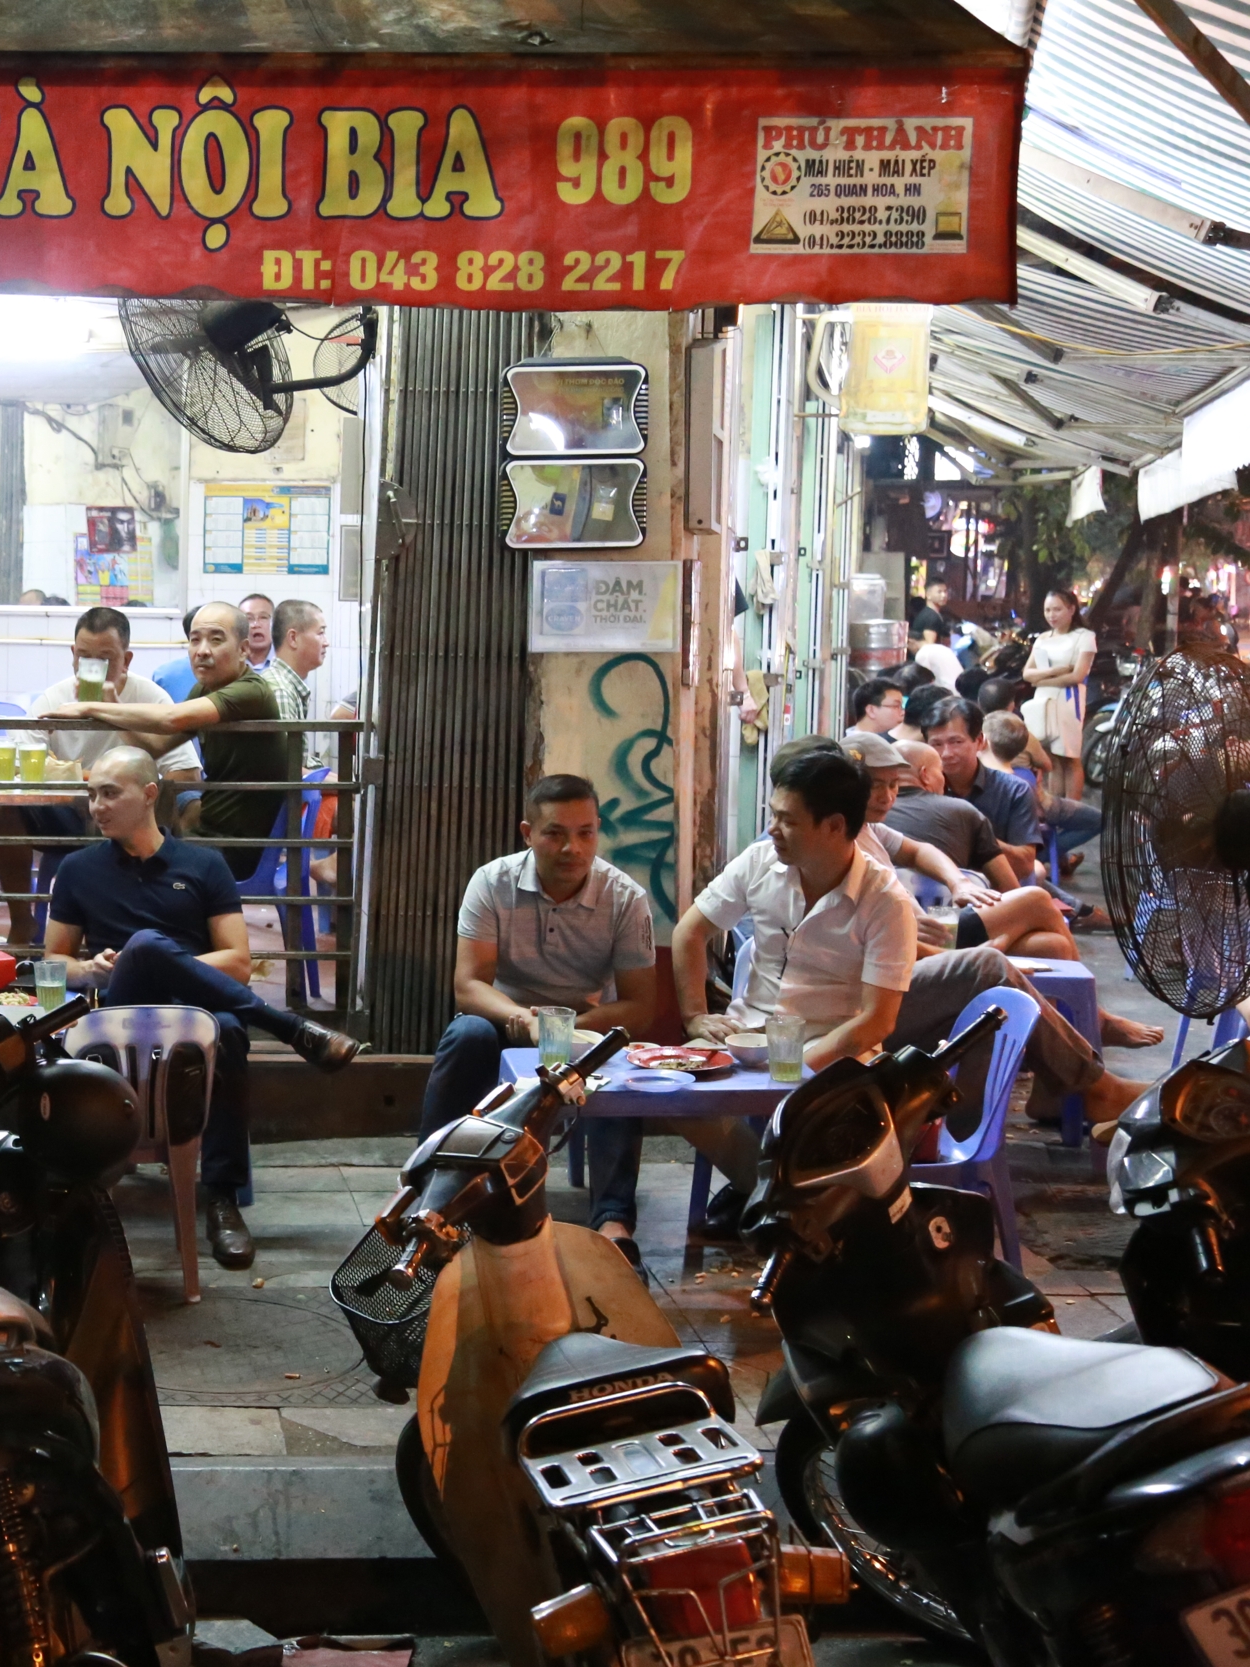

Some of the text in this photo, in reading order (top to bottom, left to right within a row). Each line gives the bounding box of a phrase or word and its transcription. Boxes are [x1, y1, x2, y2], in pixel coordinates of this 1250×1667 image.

[761, 119, 966, 151] PHÚ THÀNH
[101, 76, 293, 251] NỘI
[316, 105, 504, 220] BIA
[556, 116, 693, 205] 989
[804, 155, 828, 178] MÁI
[832, 155, 865, 178] HIÊN
[878, 155, 905, 178] MÁI
[910, 153, 937, 178] XẾP
[809, 183, 922, 199] 265 QUAN HOA, HN
[803, 205, 927, 227] (04).3828.7390
[802, 229, 926, 251] (04).2232.8888
[261, 249, 686, 291] ĐT: 043 828 2217
[569, 1372, 674, 1402] HONDA
